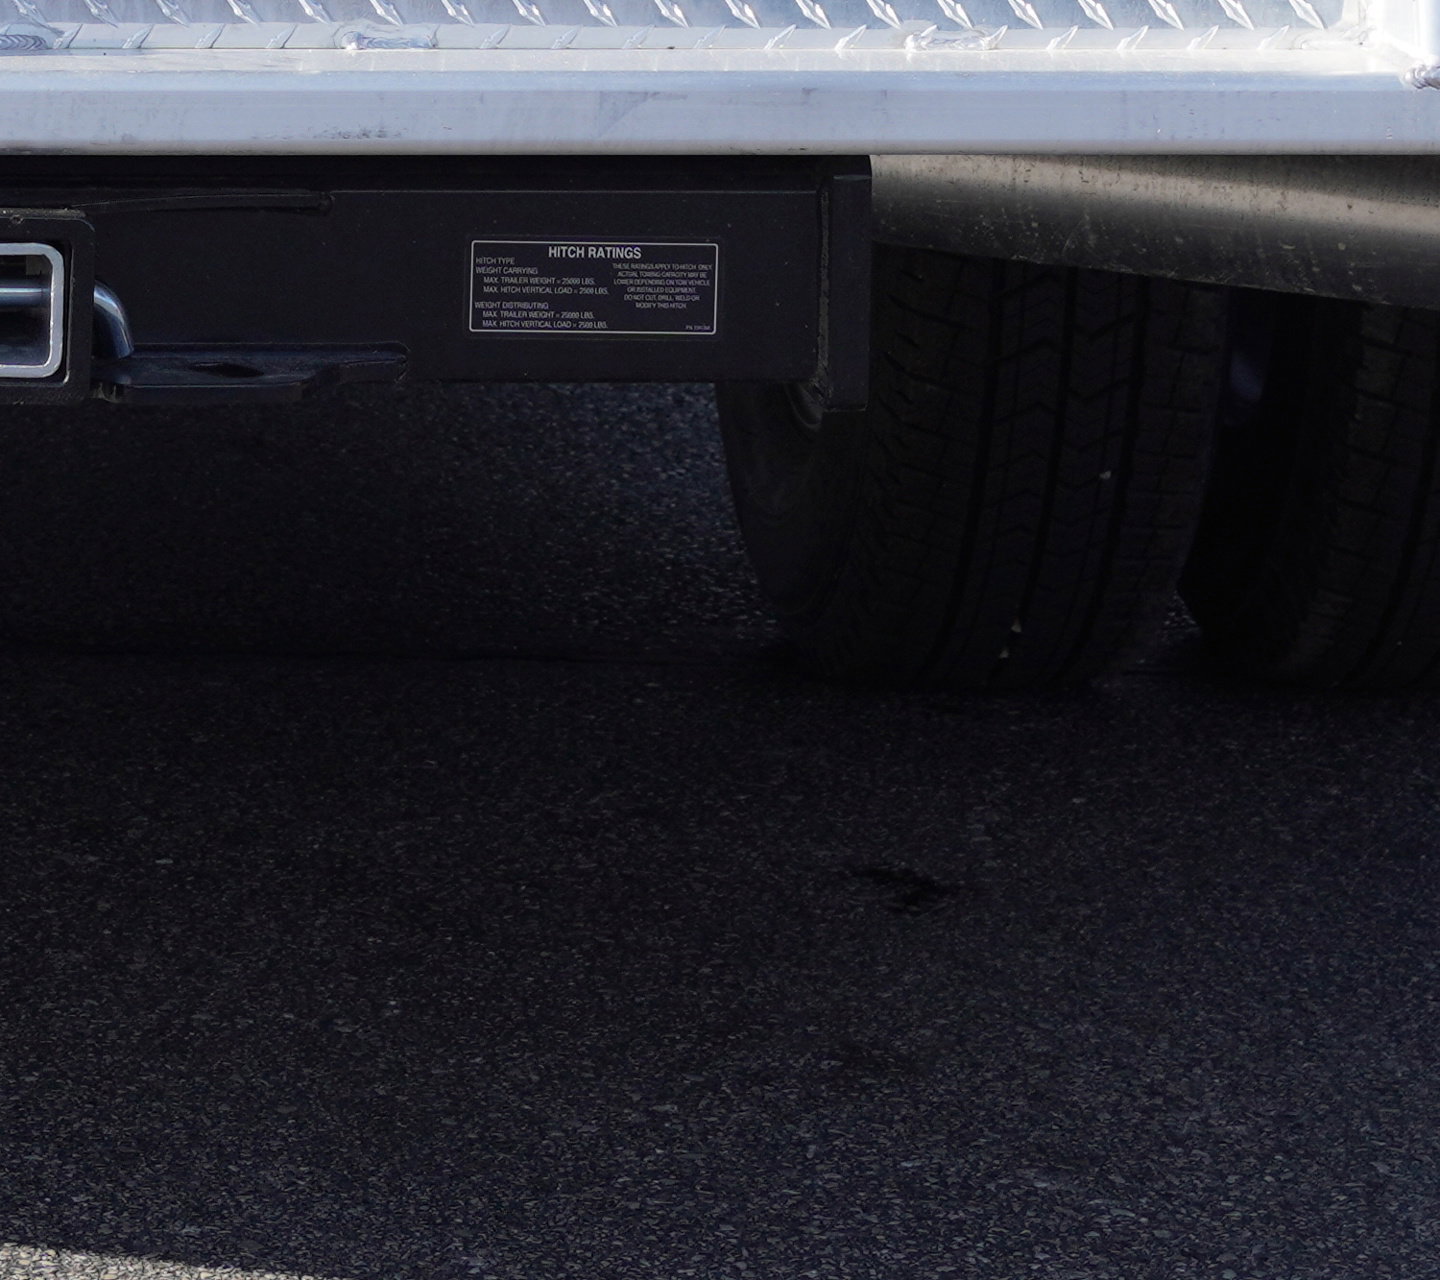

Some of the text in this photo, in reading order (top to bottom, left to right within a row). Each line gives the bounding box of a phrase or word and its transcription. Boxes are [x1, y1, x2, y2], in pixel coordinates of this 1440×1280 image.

[548, 246, 642, 259] HITCH RATINGS
[498, 257, 515, 265] TYPE
[521, 286, 553, 294] VERTICAL
[475, 301, 549, 309] WEIGHT DISTRIBUTING
[528, 311, 555, 319] WEIGHT
[499, 320, 520, 328] HITCH
